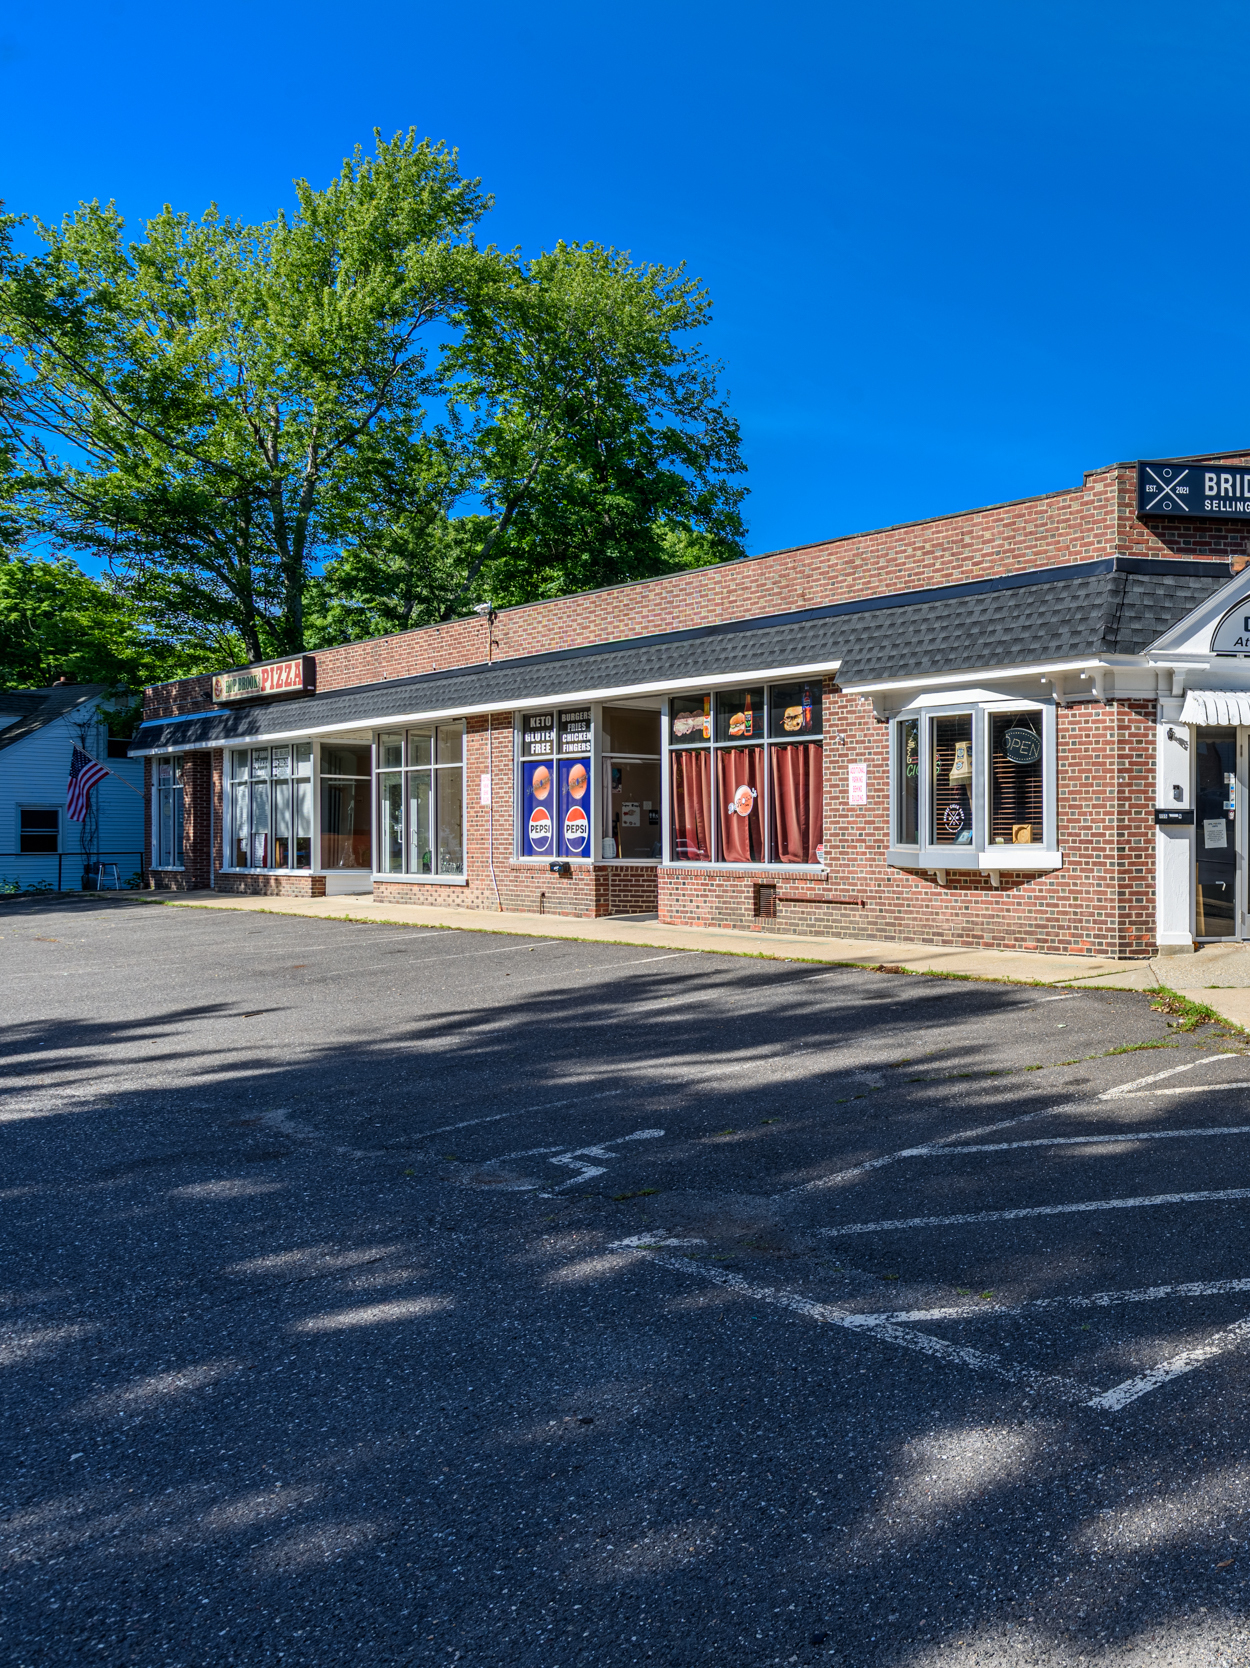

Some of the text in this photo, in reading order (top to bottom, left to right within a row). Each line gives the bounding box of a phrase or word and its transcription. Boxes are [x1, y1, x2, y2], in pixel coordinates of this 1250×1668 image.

[1146, 484, 1158, 492] EST.
[1176, 486, 1189, 494] 2021
[1233, 637, 1250, 647] At
[225, 661, 303, 693] HOP BROOK PIZZA
[530, 715, 552, 728] KETO
[561, 711, 591, 722] BURGERS
[567, 722, 586, 732] FRIES
[562, 732, 591, 742] CHICKEN
[530, 742, 551, 754] FREE
[562, 742, 591, 752] FINGERS
[1002, 735, 1040, 757] OPEN
[530, 824, 550, 833] PEPSI
[566, 824, 587, 834] PEPSI
